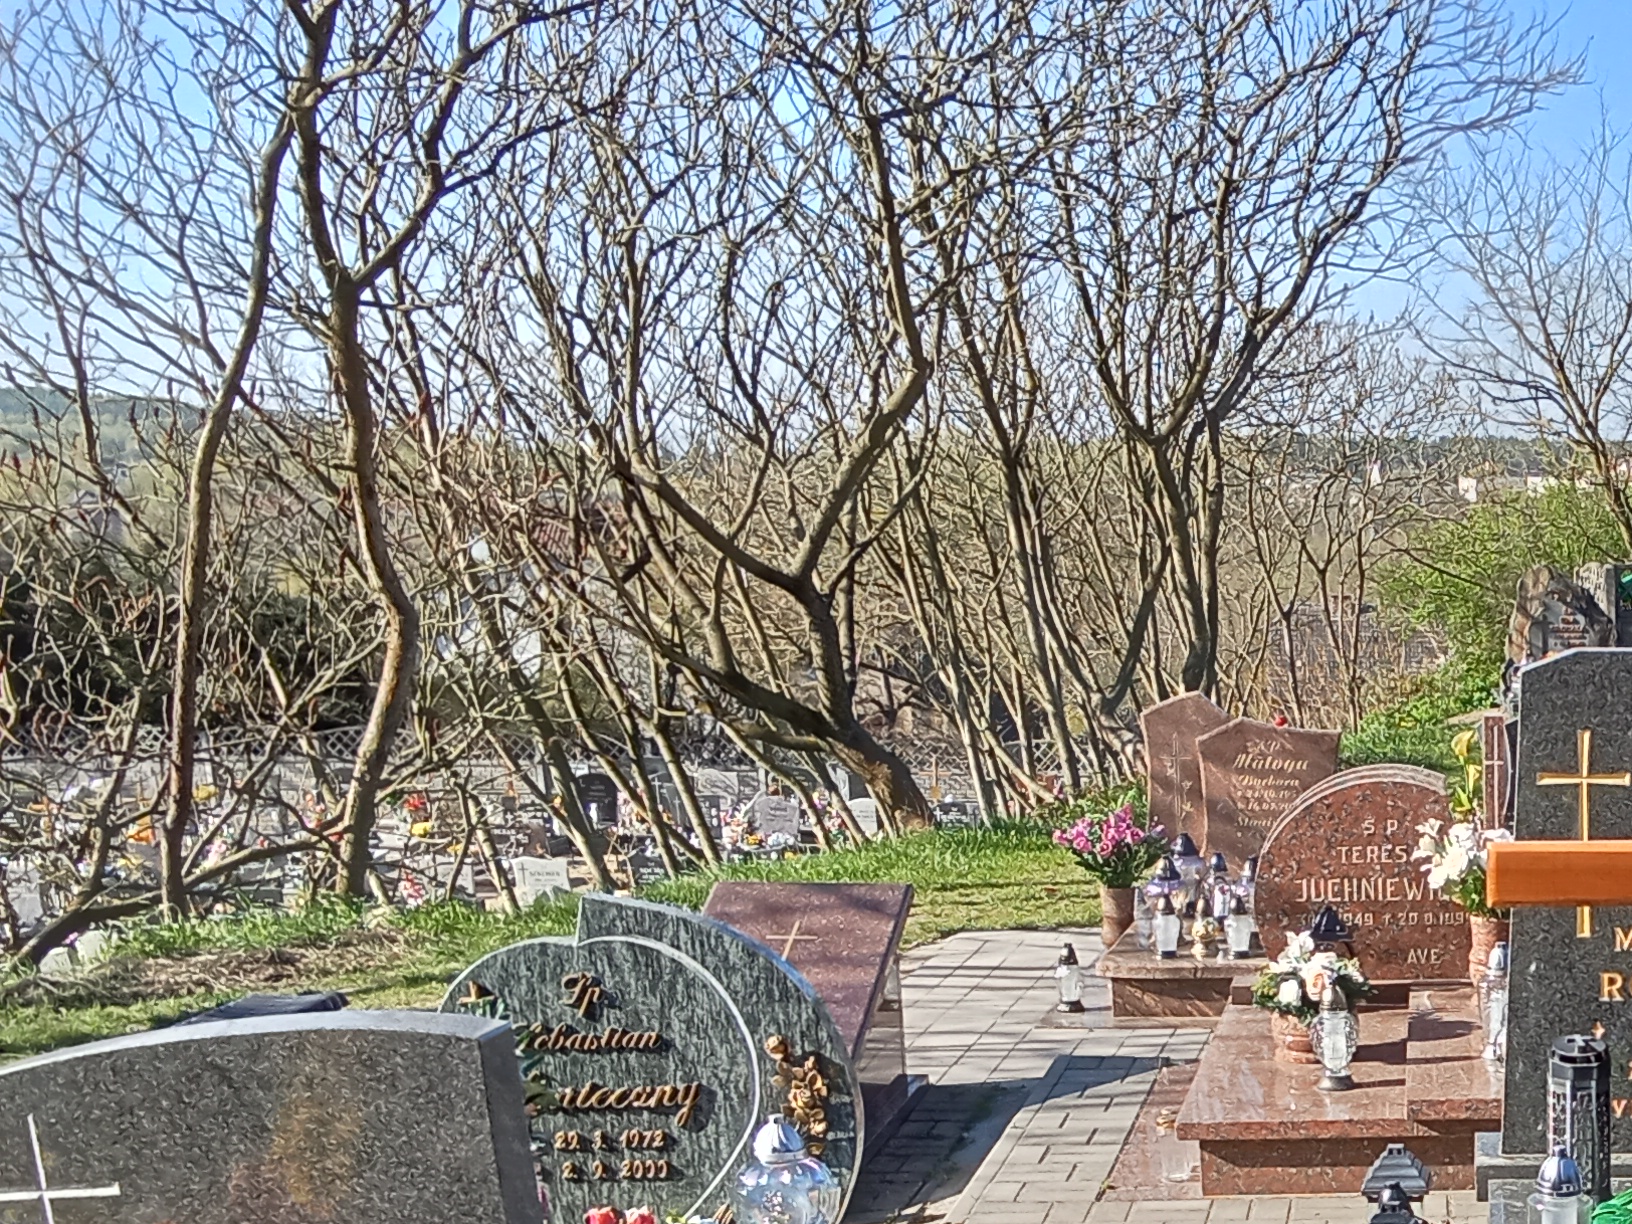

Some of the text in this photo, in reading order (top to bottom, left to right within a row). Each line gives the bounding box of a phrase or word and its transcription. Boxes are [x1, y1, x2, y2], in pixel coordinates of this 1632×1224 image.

[1336, 845, 1409, 864] TERES
[1407, 947, 1442, 965] AVE
[619, 1128, 665, 1149] 1972
[619, 1158, 668, 1179] 2000
